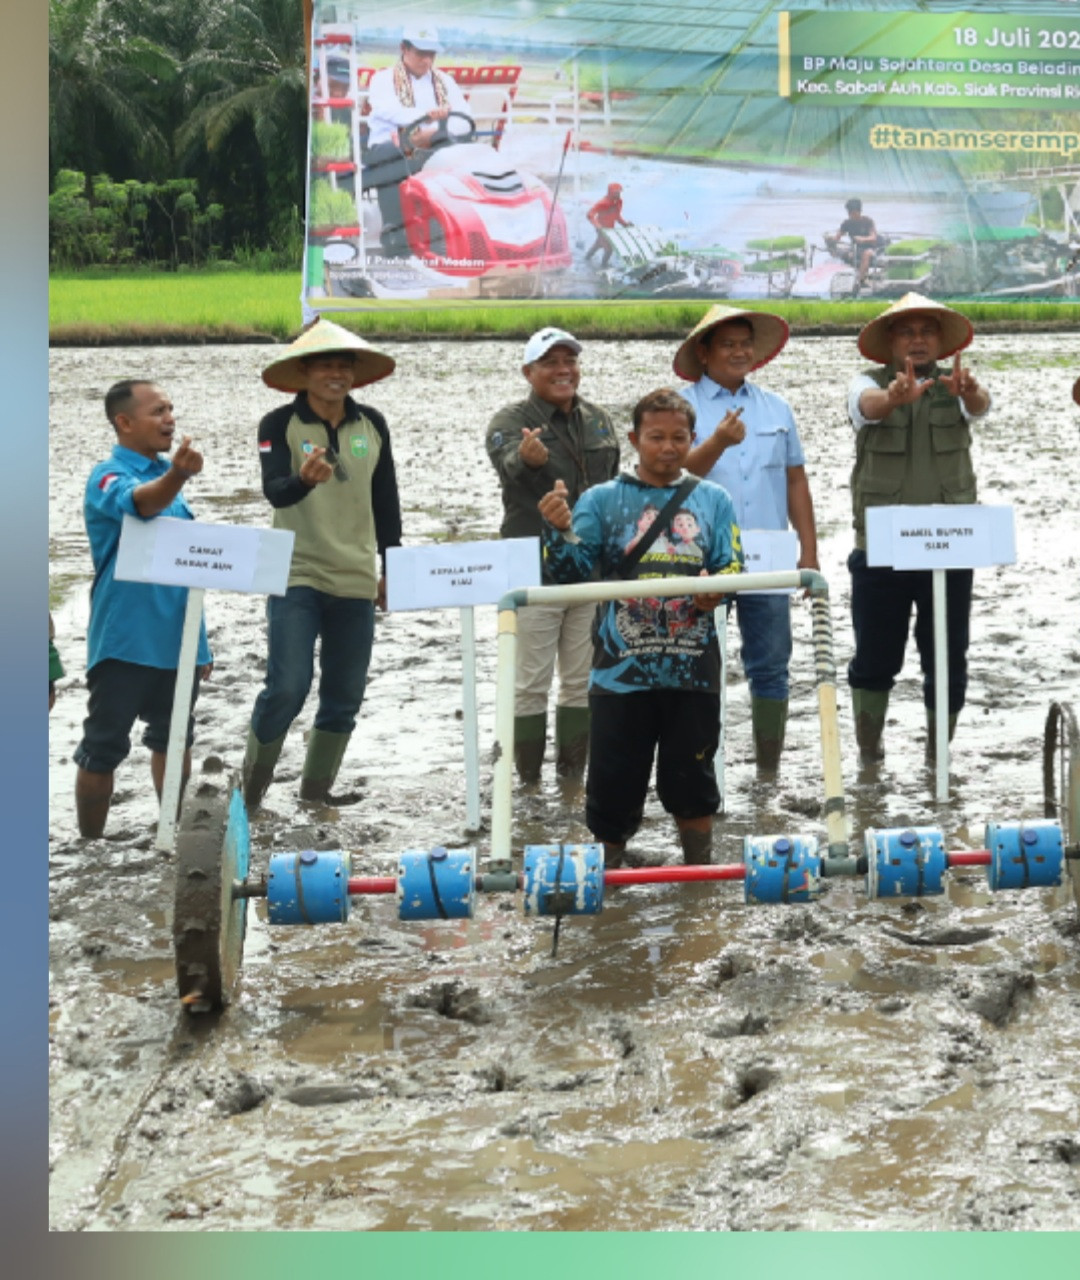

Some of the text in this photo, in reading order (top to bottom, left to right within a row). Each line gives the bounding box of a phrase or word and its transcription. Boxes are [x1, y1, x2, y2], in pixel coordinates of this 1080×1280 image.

[953, 27, 978, 47] 18
[984, 27, 1031, 48] Juli
[803, 56, 825, 71] BP
[830, 56, 873, 75] Maju
[879, 57, 965, 75] Sejahtera
[969, 59, 1013, 75] Desa
[797, 78, 832, 95] Kec.
[835, 79, 887, 96] Sabak
[890, 80, 921, 96] Auh
[923, 81, 962, 98] Kab.
[963, 82, 999, 98] Siak
[1000, 83, 1062, 99] Provinsi
[441, 257, 485, 268] Modern
[899, 526, 975, 538] WAKIL BUPATI
[188, 545, 223, 556] CAMAT
[924, 541, 951, 552] SIAK
